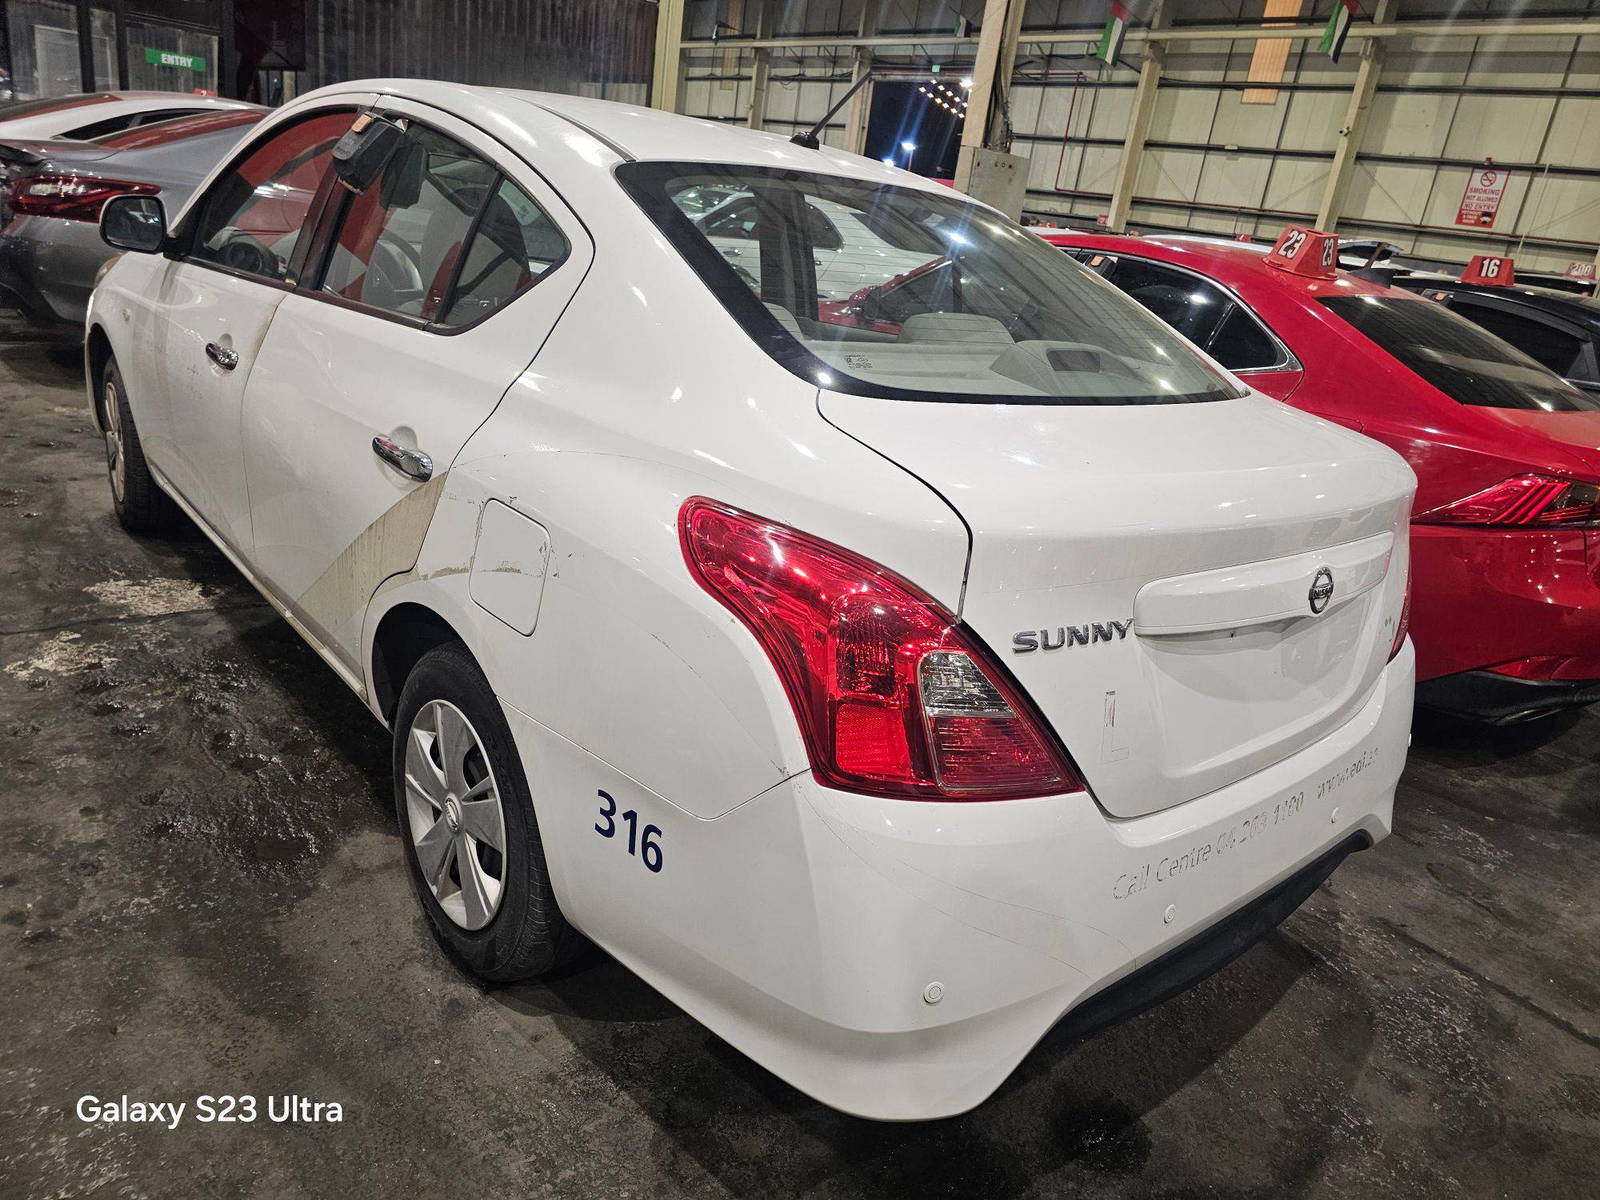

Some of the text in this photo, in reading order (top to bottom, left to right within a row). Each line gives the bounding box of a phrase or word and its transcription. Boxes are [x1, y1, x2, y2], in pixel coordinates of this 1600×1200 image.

[161, 53, 192, 68] ENTRY
[1469, 187, 1500, 195] SMOKING
[1278, 230, 1307, 259] 23
[1322, 238, 1334, 266] 23
[1480, 258, 1501, 278] 16
[1012, 618, 1134, 654] SUNNY
[594, 788, 663, 873] 316
[1156, 843, 1212, 882] Centre
